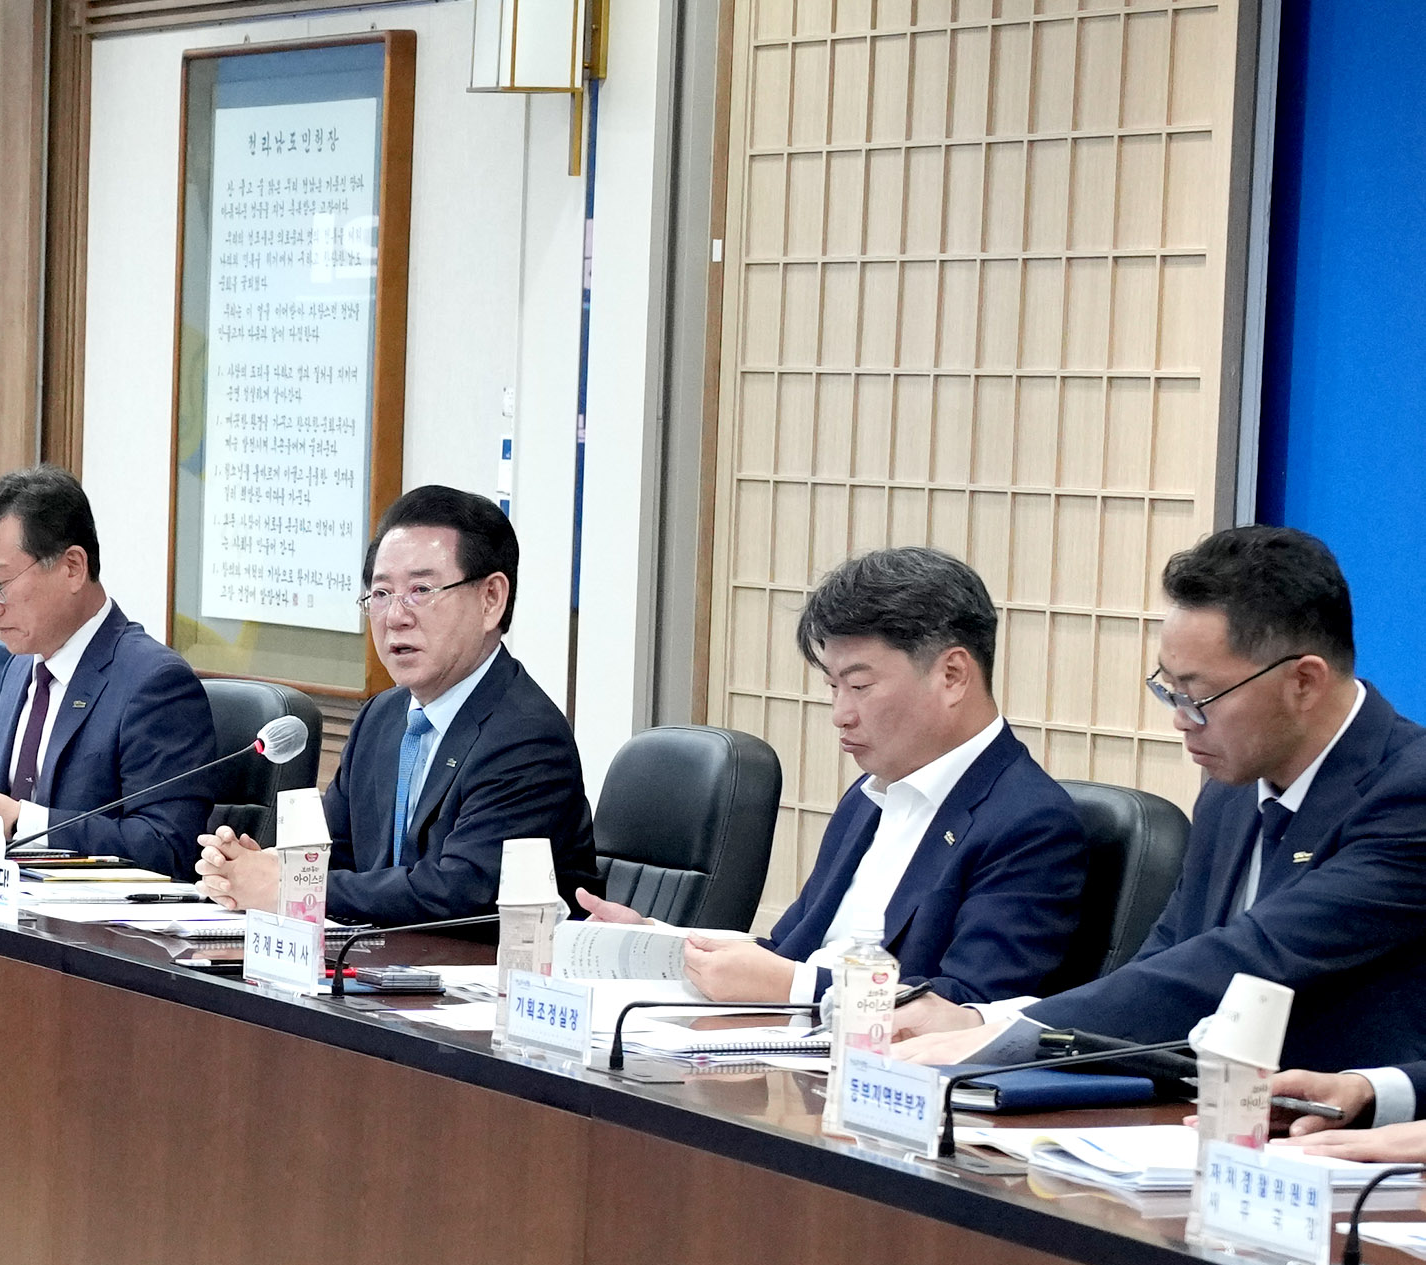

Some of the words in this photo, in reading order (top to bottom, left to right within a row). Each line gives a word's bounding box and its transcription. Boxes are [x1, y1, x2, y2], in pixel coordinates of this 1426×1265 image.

[252, 932, 309, 966] 경제부지사
[515, 996, 579, 1031] 기획조정실장
[850, 1078, 926, 1120] 동부지역본부장
[1210, 1163, 1317, 1207] 자치경찰위원회
